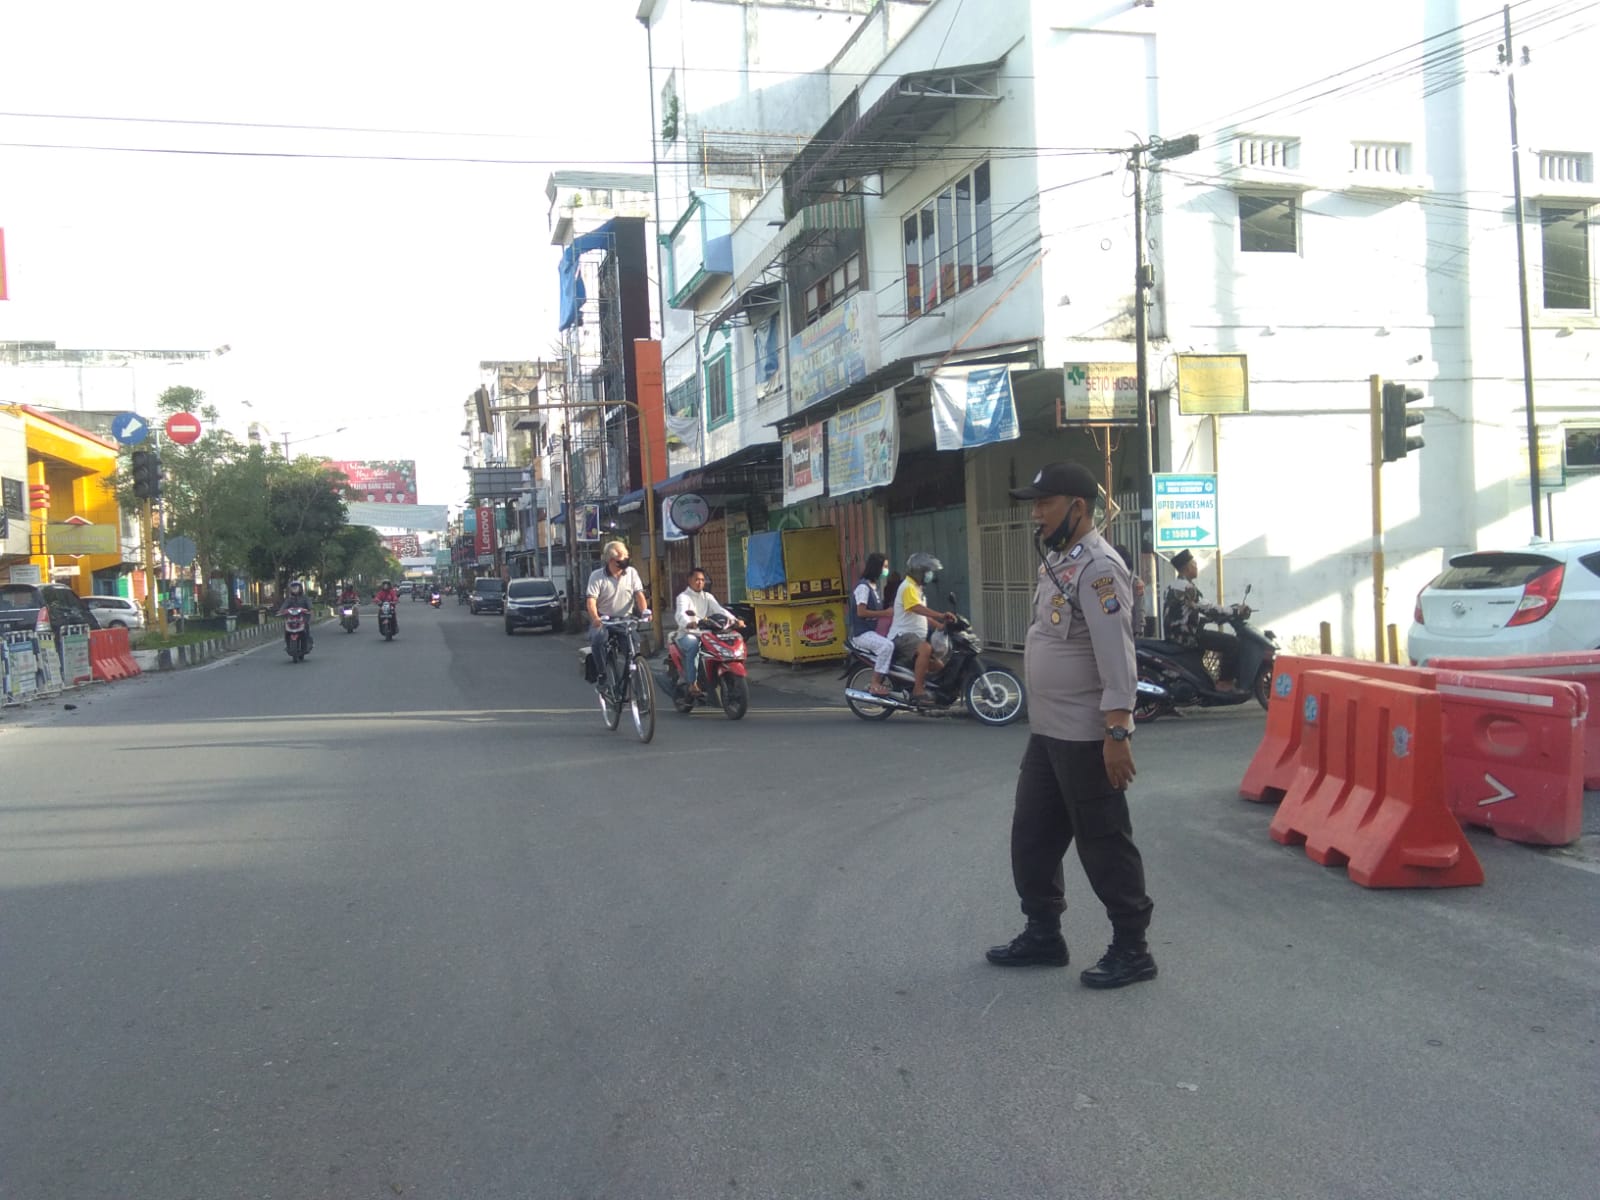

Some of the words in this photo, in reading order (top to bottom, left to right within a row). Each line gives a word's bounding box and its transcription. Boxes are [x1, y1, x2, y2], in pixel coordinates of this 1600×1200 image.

[1086, 376, 1110, 391] SETIO
[1175, 500, 1214, 510] PUSKESMAS
[1170, 511, 1201, 521] MUTIARA
[480, 510, 491, 550] Lenovo
